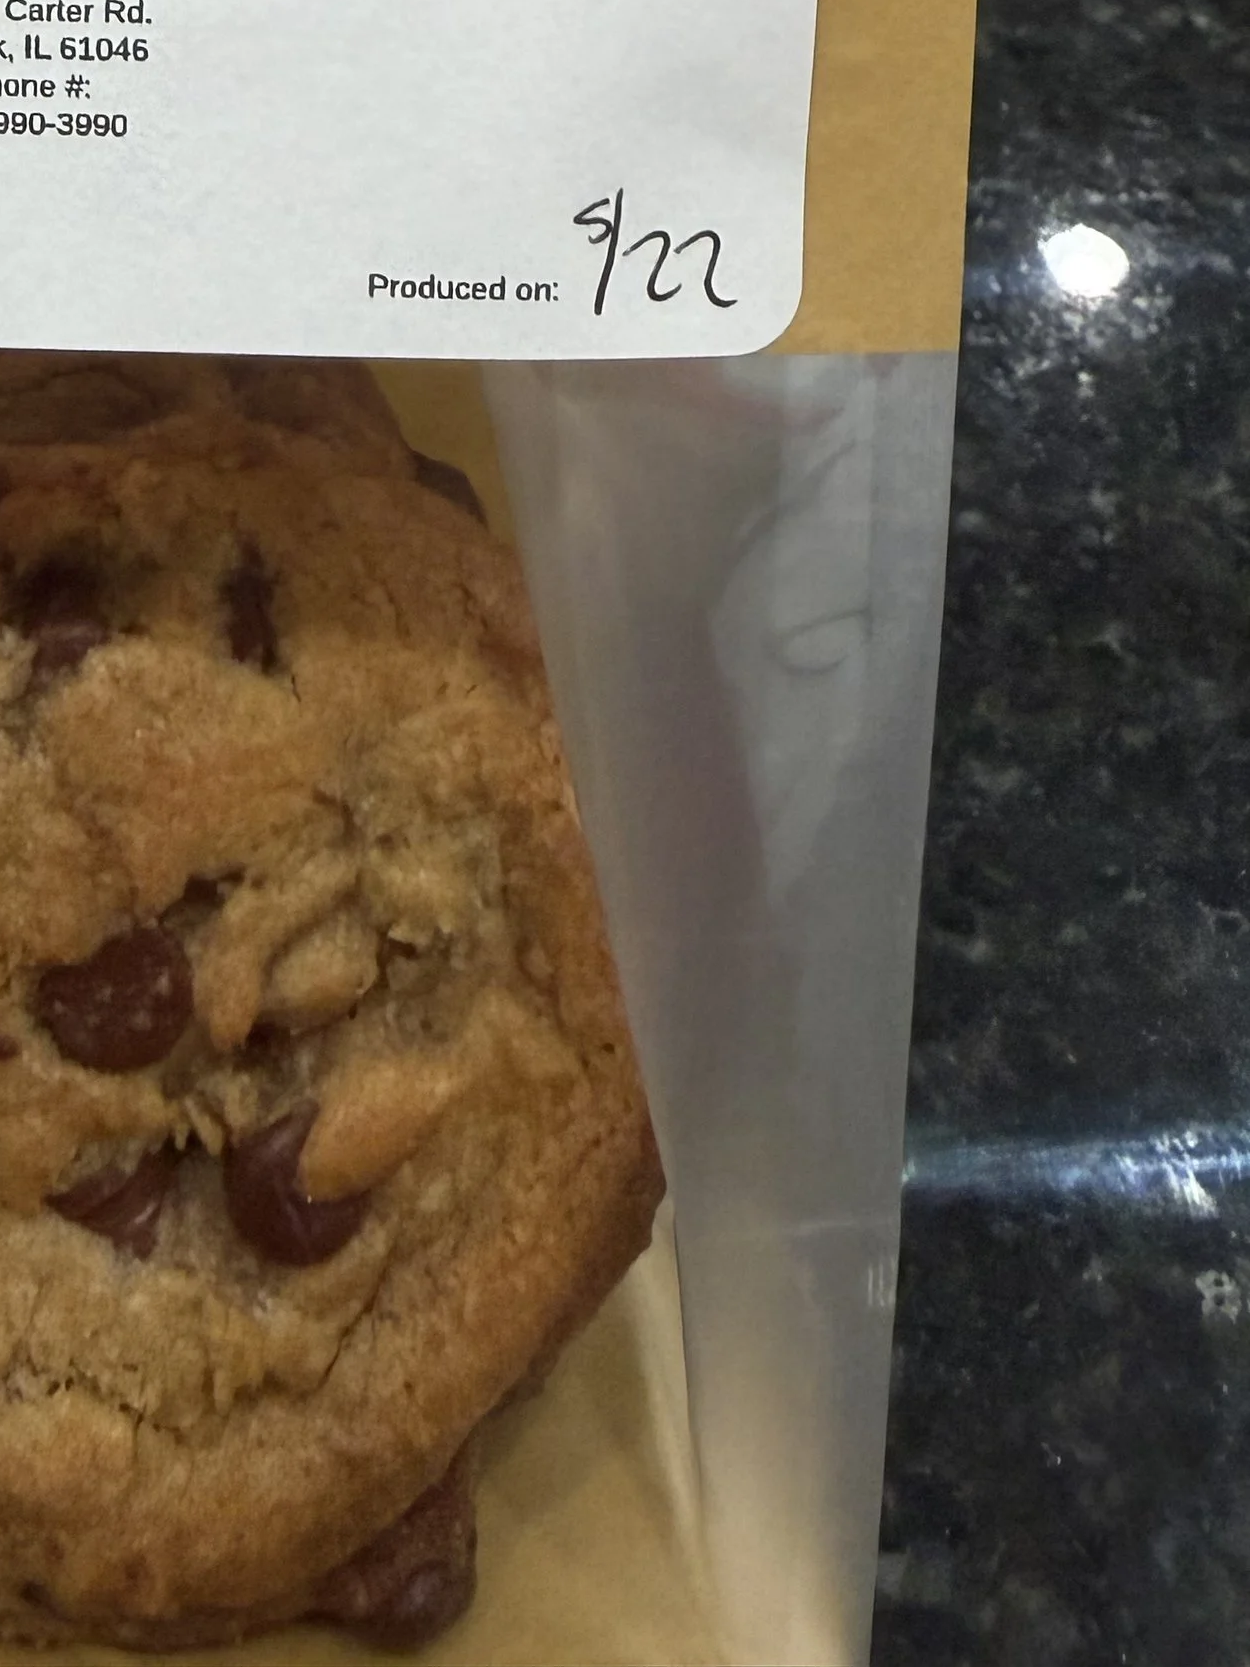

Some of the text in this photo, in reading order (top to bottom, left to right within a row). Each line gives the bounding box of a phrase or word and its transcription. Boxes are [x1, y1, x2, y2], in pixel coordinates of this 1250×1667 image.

[23, 32, 53, 61] IL
[58, 35, 150, 64] 61046
[63, 72, 92, 101] #:
[571, 186, 740, 318] 5/22
[367, 272, 560, 304] Produced on:
